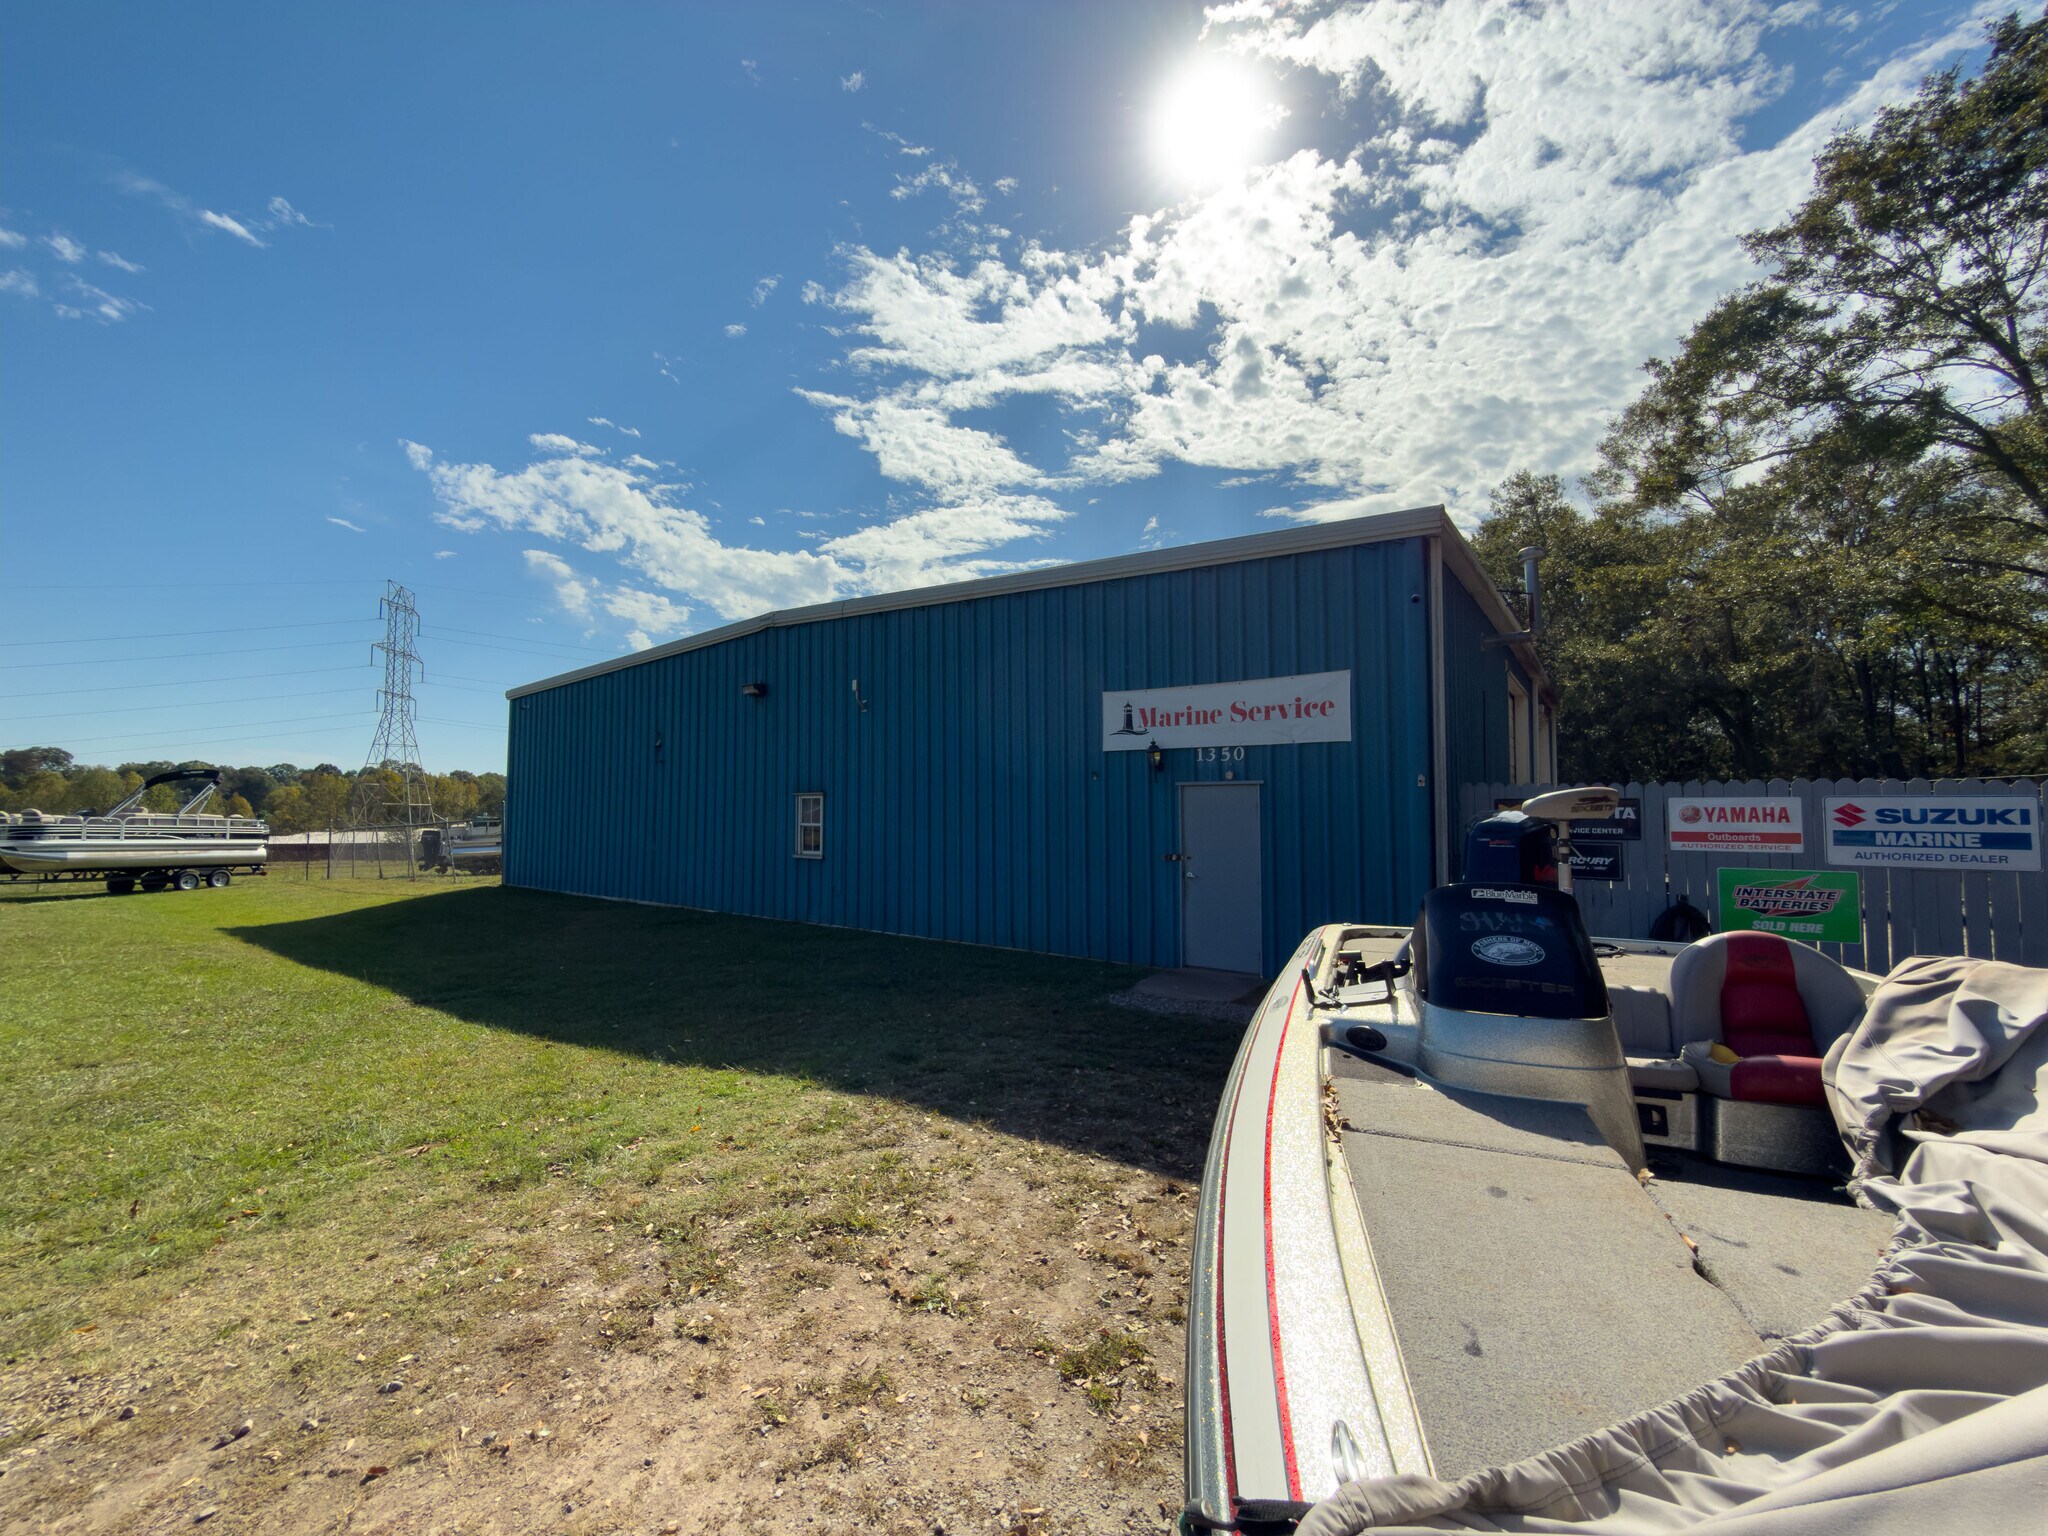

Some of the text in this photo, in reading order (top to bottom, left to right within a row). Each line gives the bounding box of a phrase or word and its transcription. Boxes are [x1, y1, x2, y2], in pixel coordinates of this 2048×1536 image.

[1138, 696, 1335, 728] Marine Service
[1195, 746, 1245, 762] 1350
[1615, 806, 1636, 819] TA
[1704, 806, 1790, 824] YAMAHA
[1875, 807, 2031, 826] SUZUKI
[1591, 827, 1624, 835] CENTER
[1707, 832, 1761, 842] Outboards
[1875, 831, 1982, 848] MARINE
[1680, 843, 1792, 852] AUTHORIZED SERVICE
[1854, 851, 2009, 865] AUTHORIZED DEALER
[1734, 886, 1840, 901] INTERSTATE
[1737, 898, 1833, 912] BATTERIES
[1752, 919, 1825, 934] SOLD HERE
